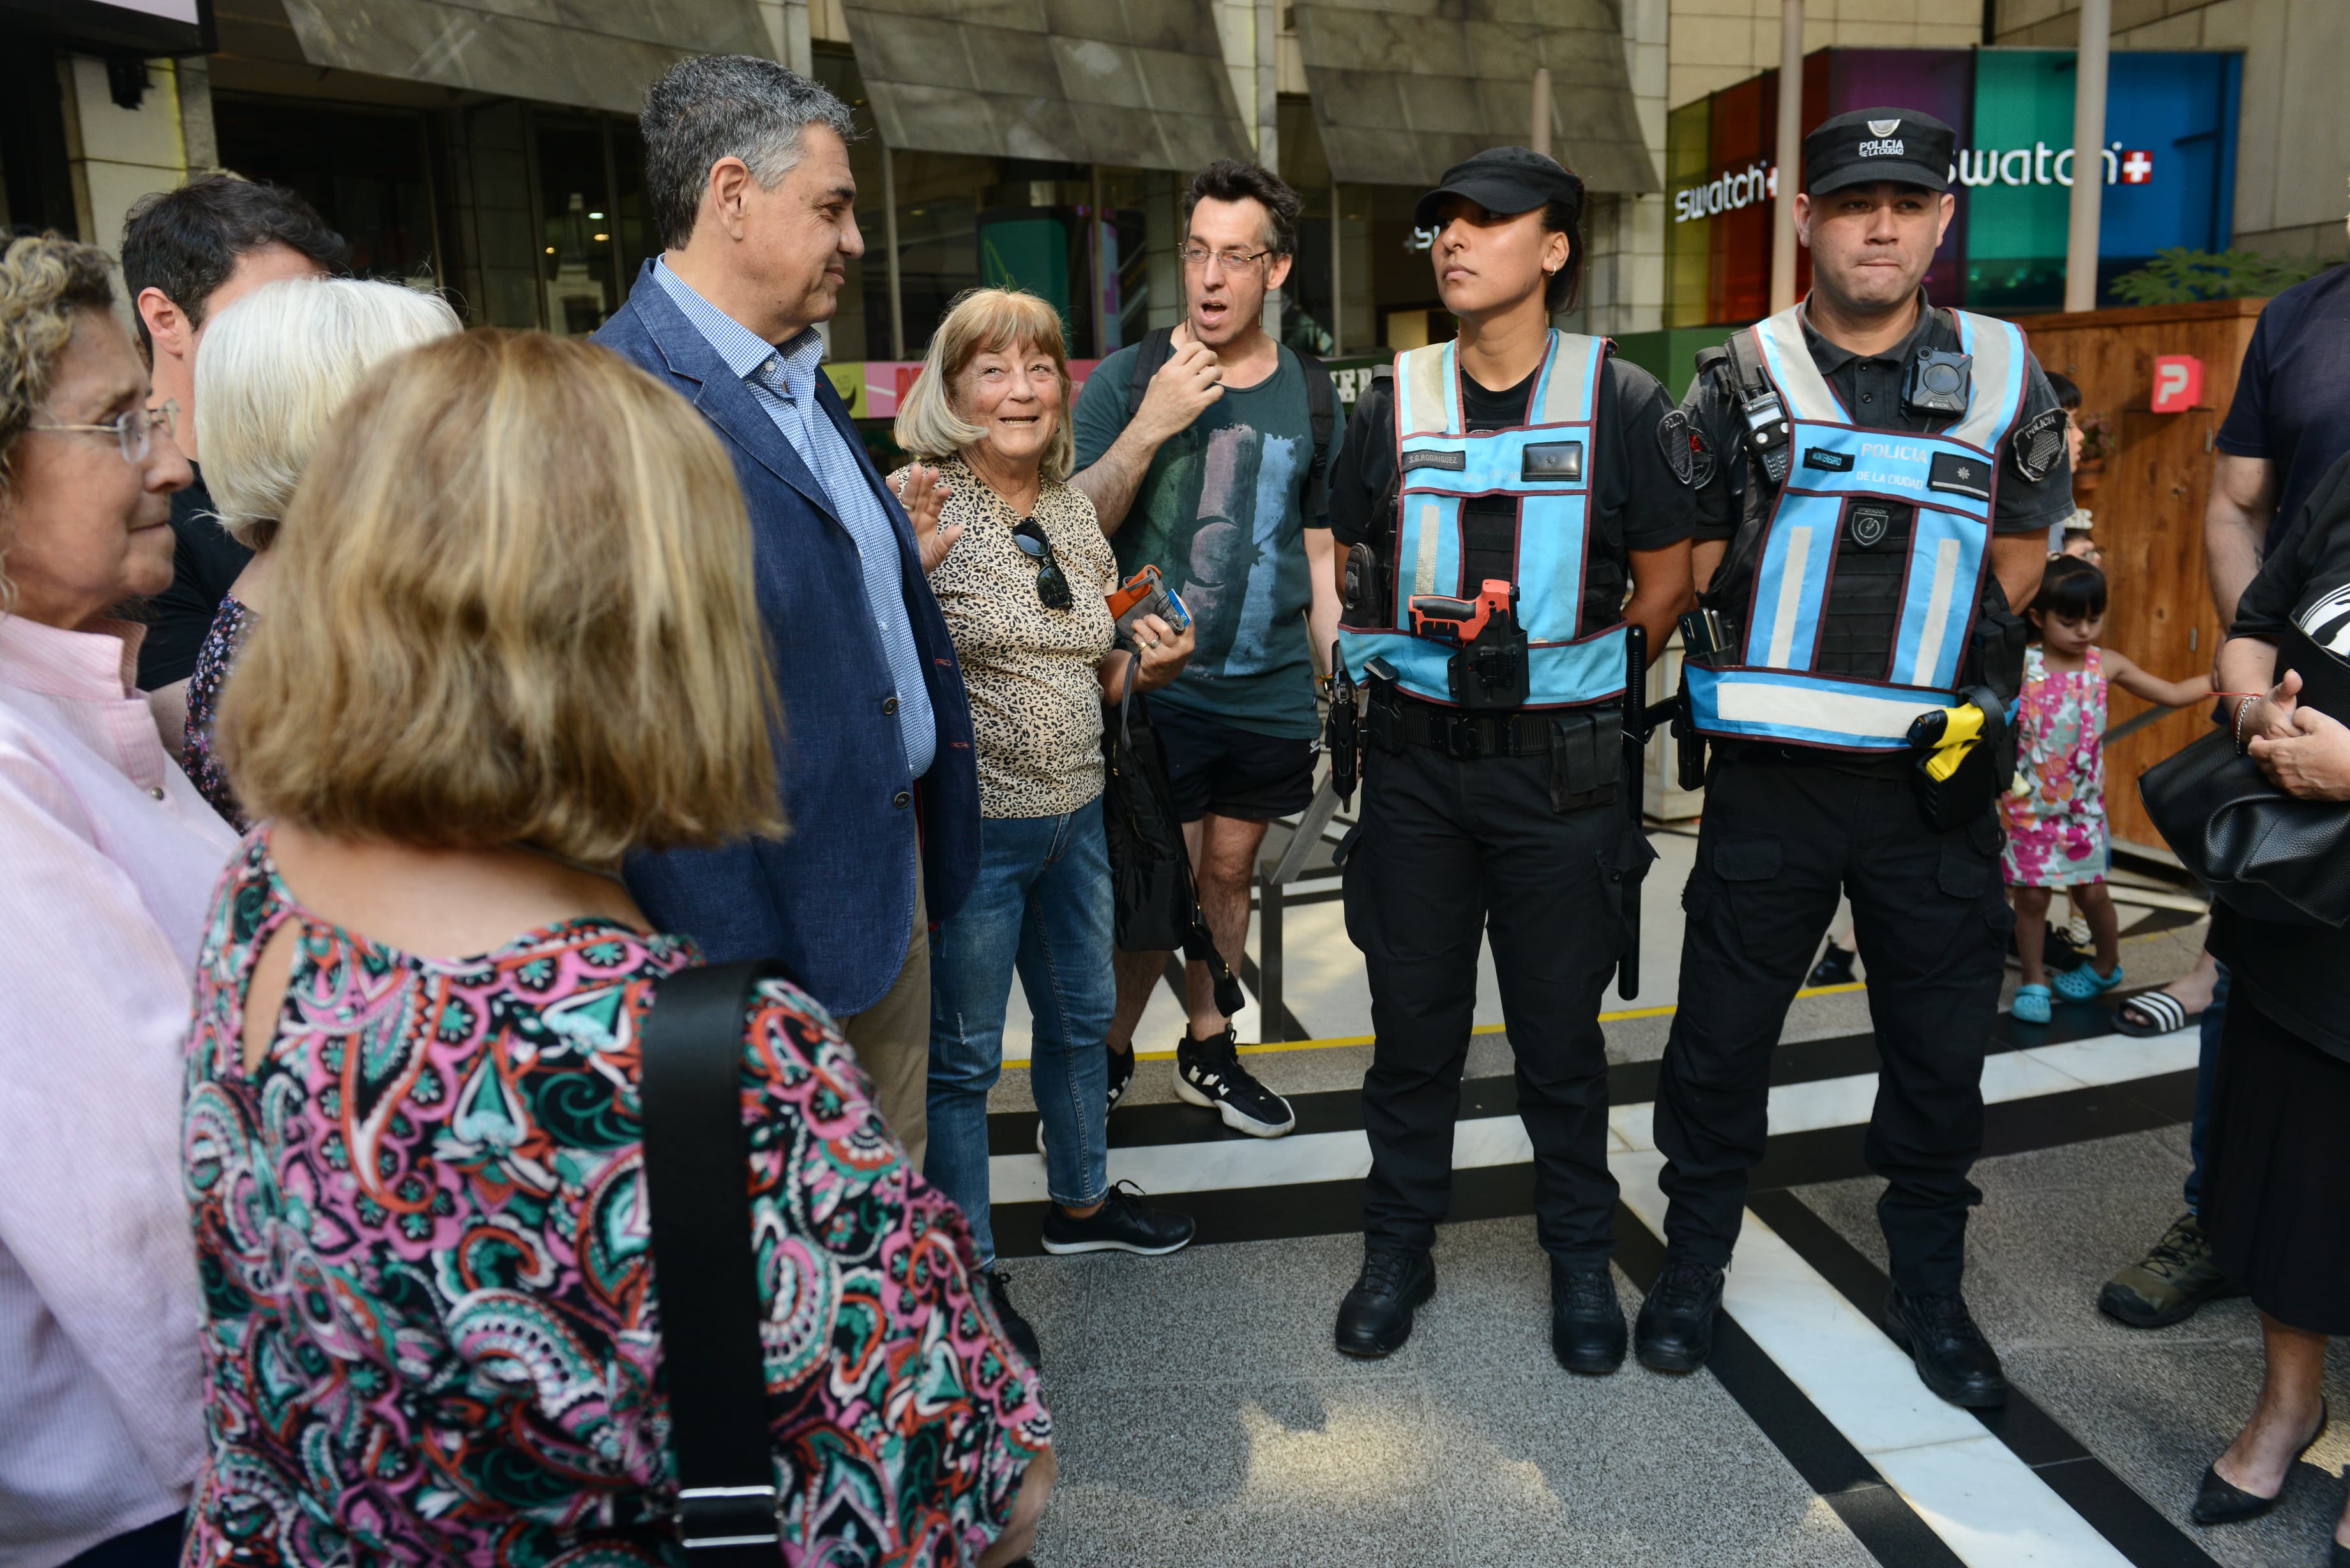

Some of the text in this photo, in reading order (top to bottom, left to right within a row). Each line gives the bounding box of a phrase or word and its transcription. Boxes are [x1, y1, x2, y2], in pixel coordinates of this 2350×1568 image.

[1859, 139, 1904, 151] POLICIA
[1674, 163, 1766, 223] swatch
[1409, 453, 1458, 464] S.G.RODRIGUEZ
[1861, 443, 1929, 465] POLICIA
[1856, 471, 1925, 490] DE LA CIUDAD
